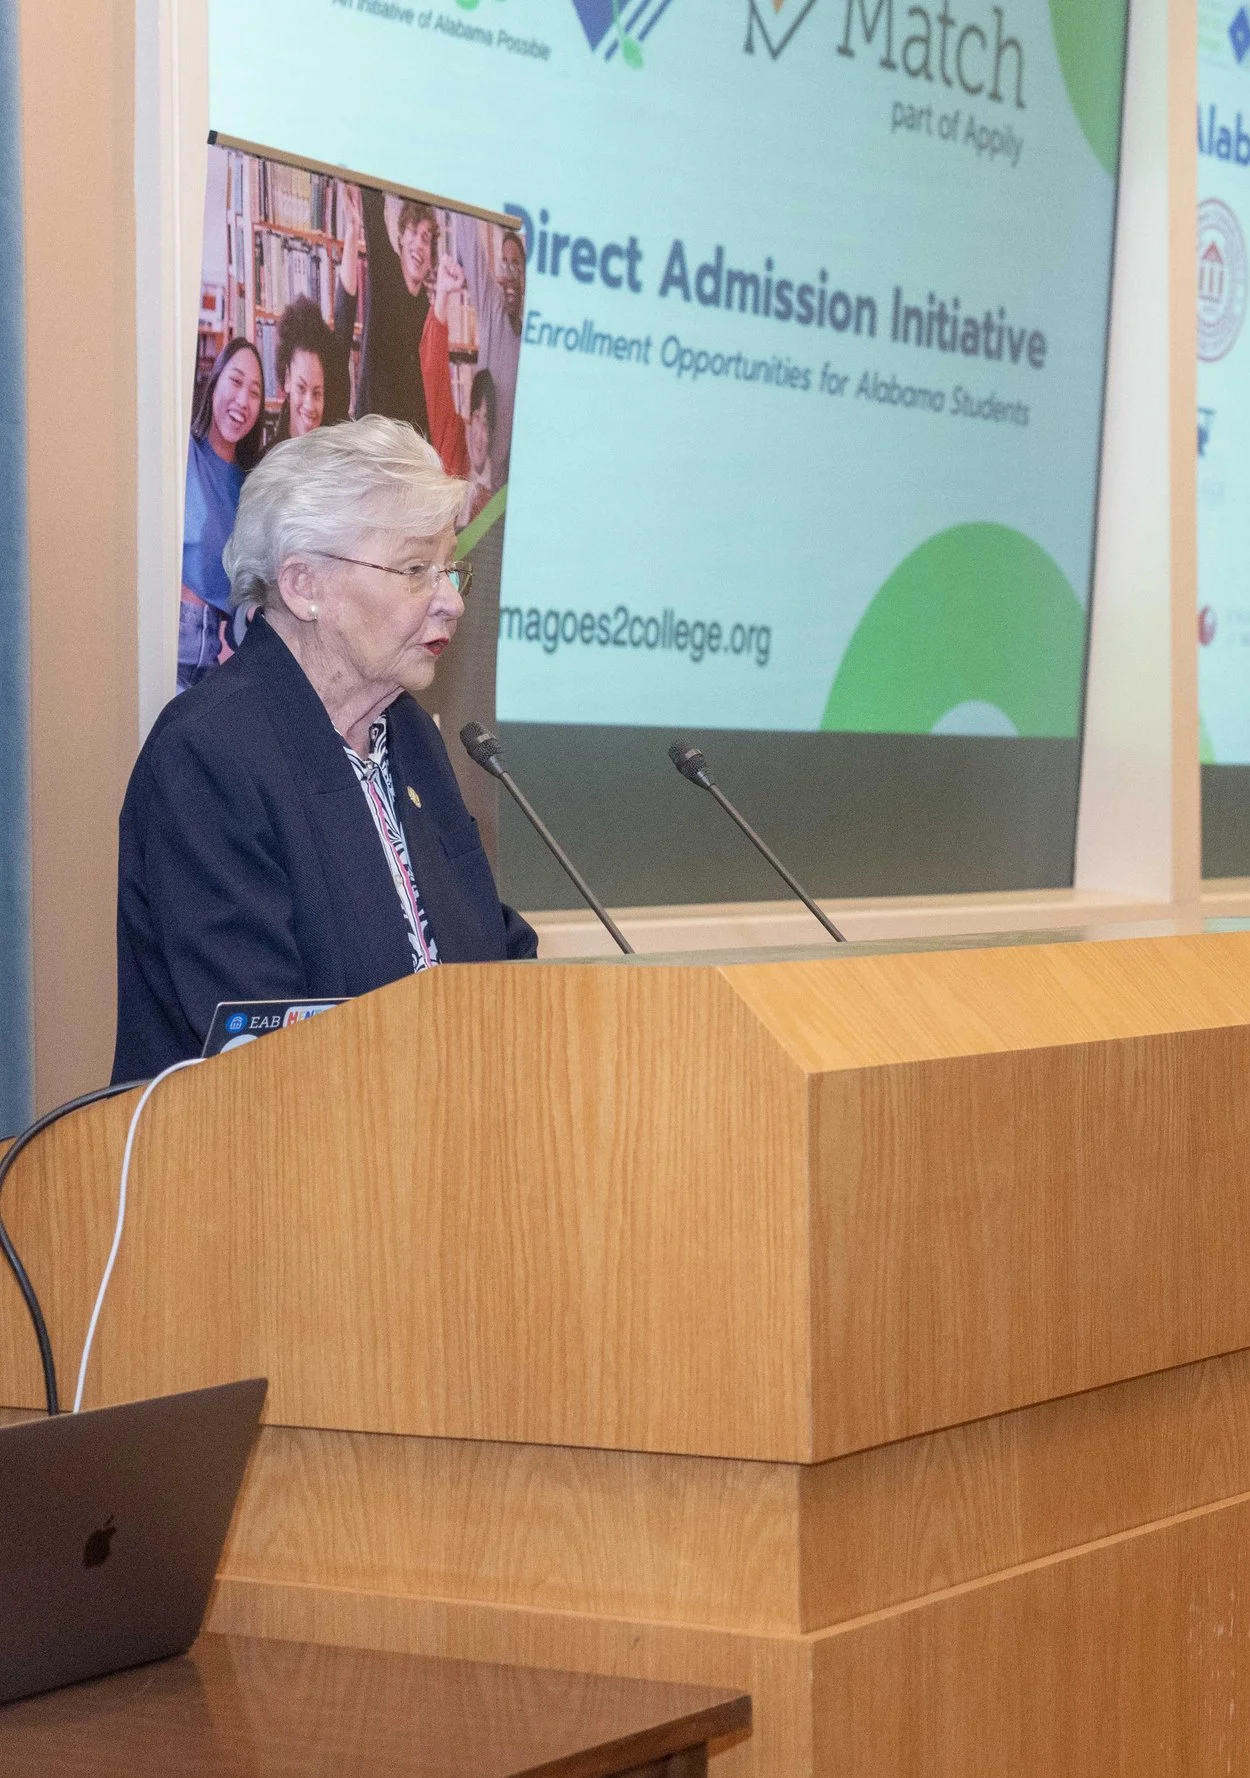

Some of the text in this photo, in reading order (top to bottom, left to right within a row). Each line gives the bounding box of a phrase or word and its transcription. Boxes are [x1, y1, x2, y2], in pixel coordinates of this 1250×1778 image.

[417, 9, 433, 29] of
[434, 13, 494, 46] Alabama
[497, 28, 551, 61] Possible
[836, 0, 1026, 109] Match
[890, 101, 933, 134] part
[938, 109, 961, 141] of
[658, 237, 878, 339] Admission
[891, 285, 1049, 370] Initiative
[524, 310, 1031, 427] Enrollment Opportunities for Alabama Students
[499, 604, 772, 667] magoes2college.org
[249, 1015, 281, 1029] EAB
